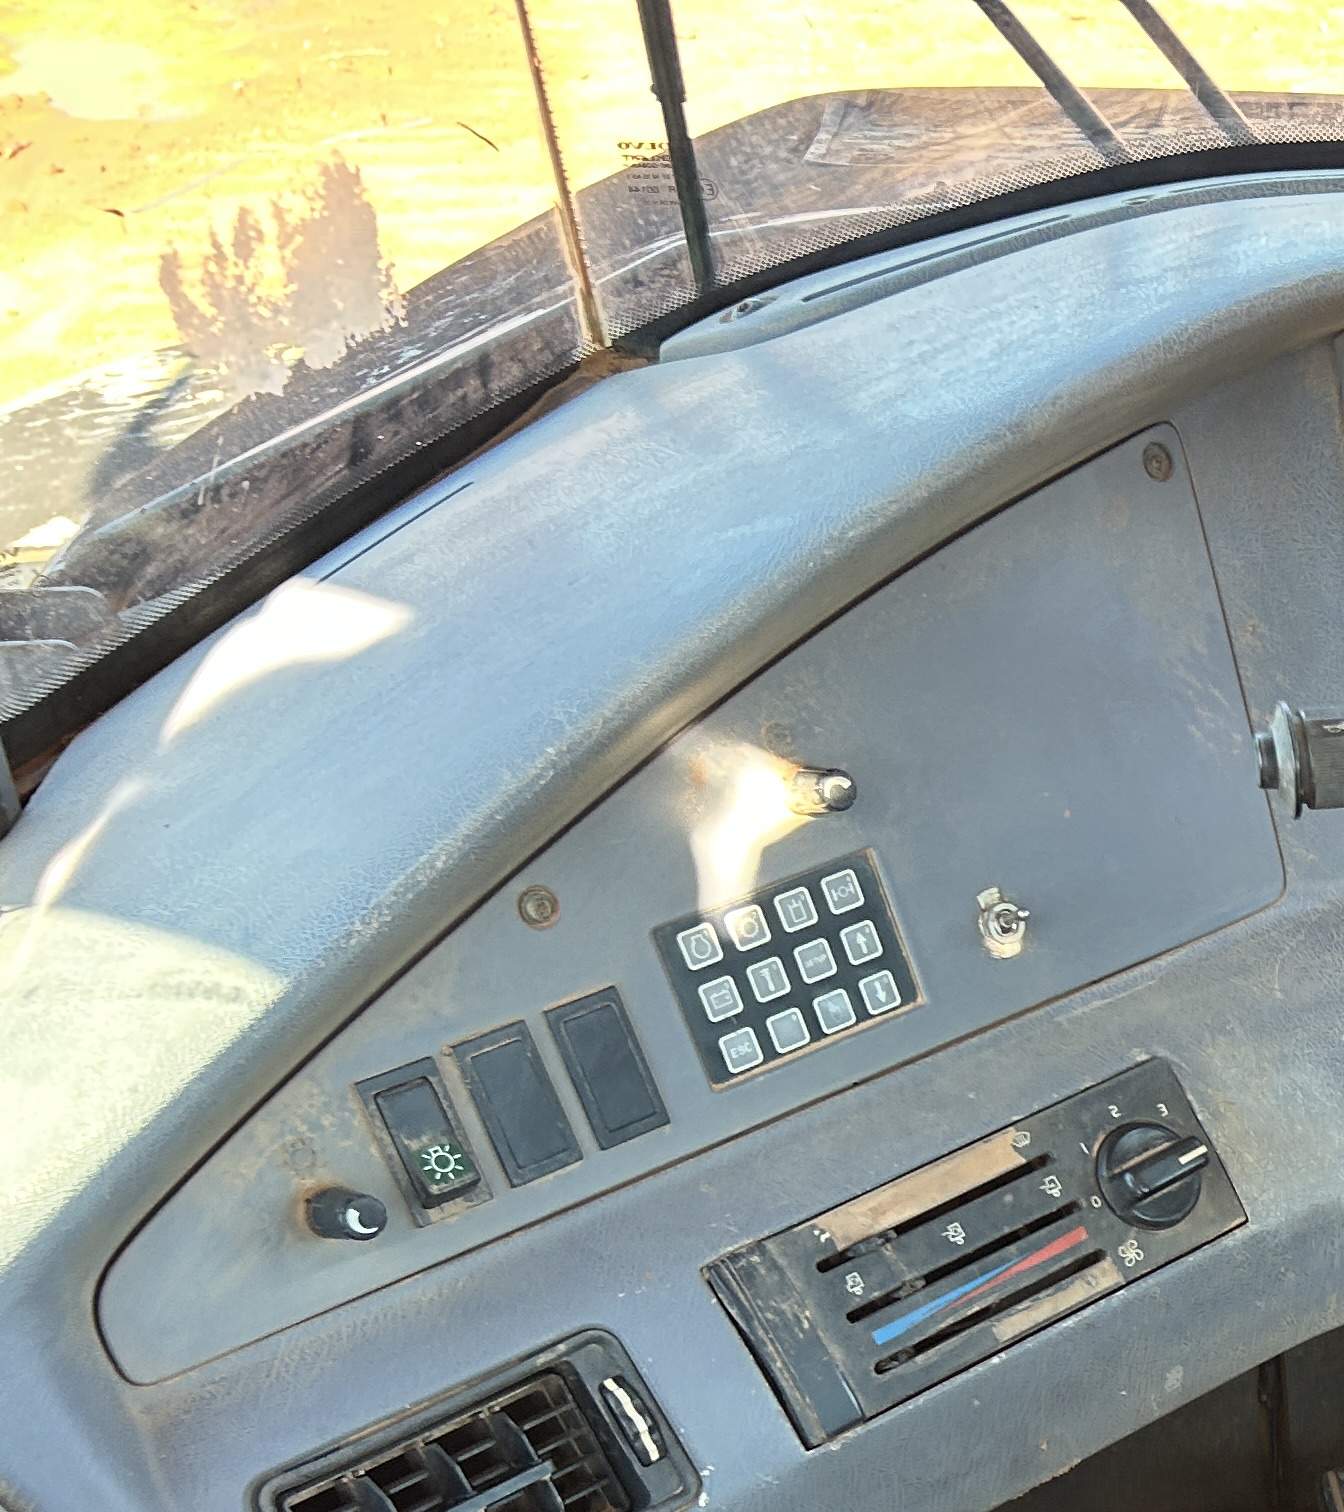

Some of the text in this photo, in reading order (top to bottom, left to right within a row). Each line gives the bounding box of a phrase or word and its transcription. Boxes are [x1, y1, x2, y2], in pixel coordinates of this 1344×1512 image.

[729, 1042, 752, 1058] ESC
[1108, 1103, 1168, 1118] 2 3
